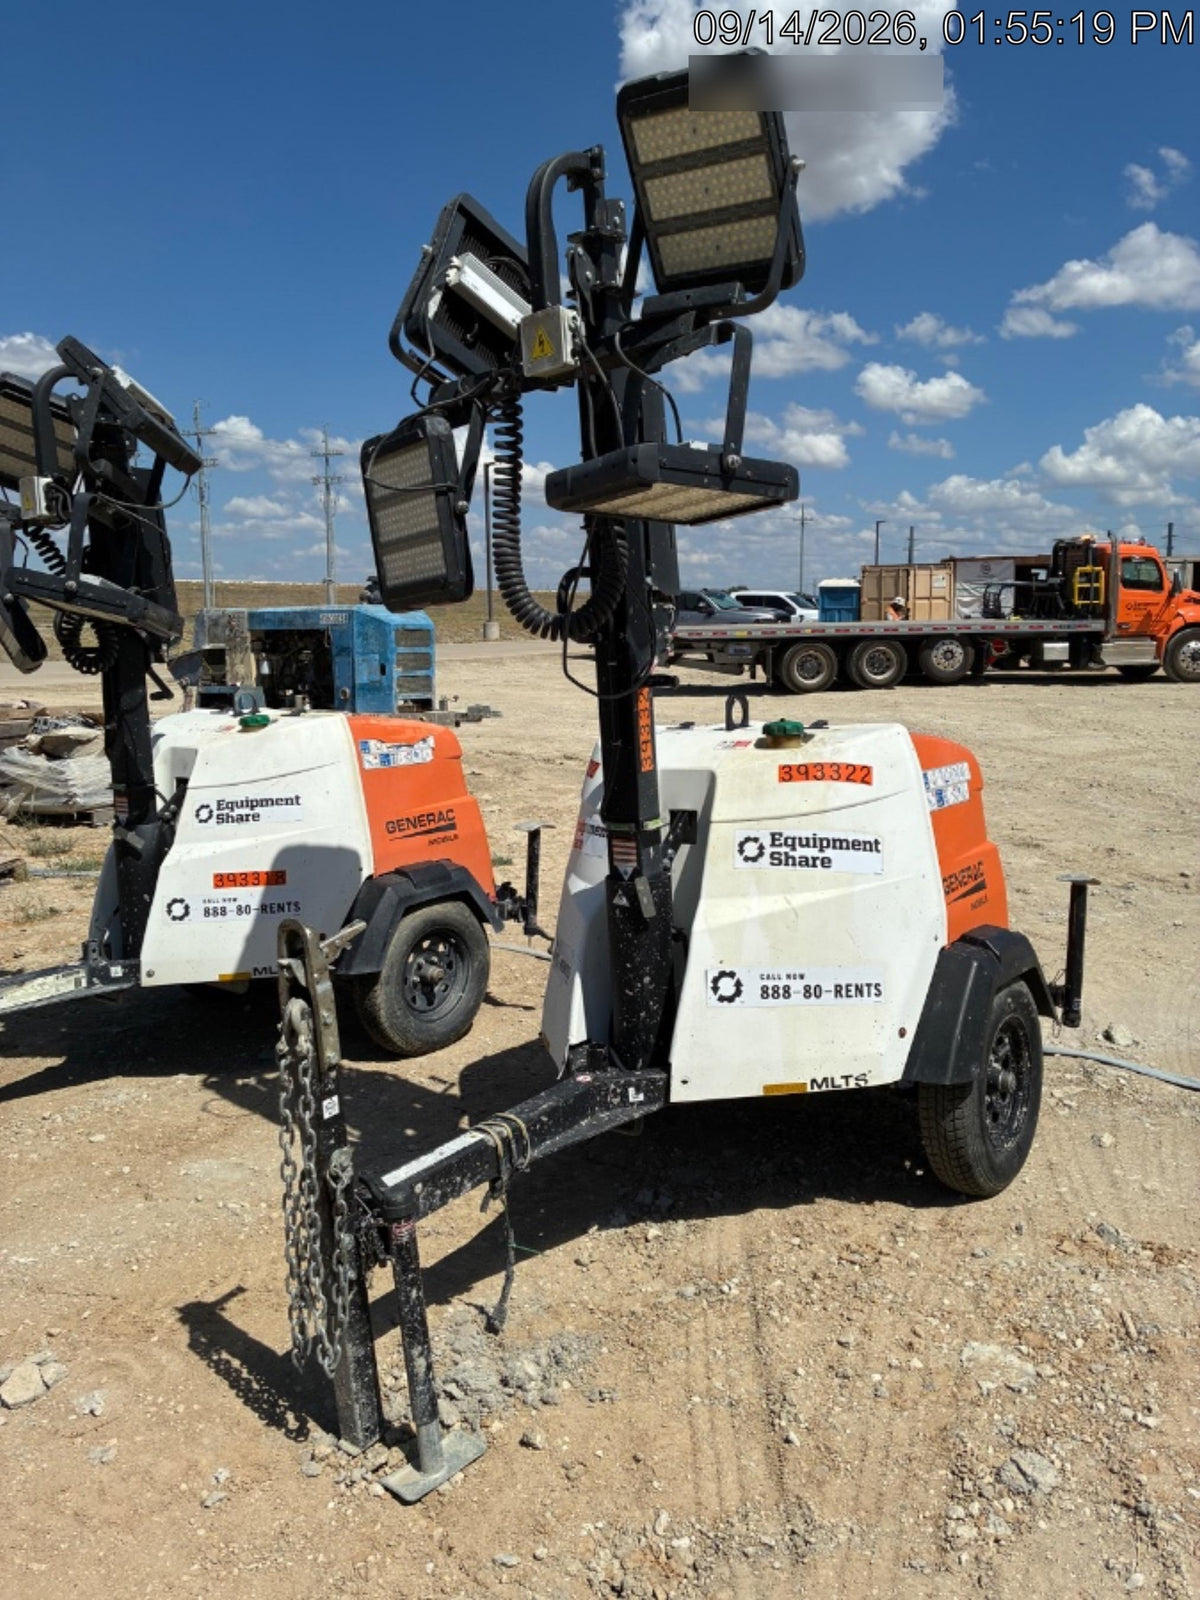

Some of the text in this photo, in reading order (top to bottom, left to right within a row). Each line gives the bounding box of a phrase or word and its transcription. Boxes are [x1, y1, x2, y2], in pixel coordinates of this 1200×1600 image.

[780, 763, 872, 784] 393322
[216, 794, 301, 811] Equipment
[216, 812, 260, 825] Share
[385, 808, 456, 834] GENERAC
[769, 831, 881, 854] Equipment
[769, 850, 832, 868] Share
[214, 871, 286, 889] 393318
[203, 901, 301, 918] 888-80-RENTS
[253, 966, 280, 976] ML
[760, 973, 805, 981] CALL NOW
[760, 982, 882, 1000] 888-80-RENTS
[810, 1073, 868, 1090] MLTS
